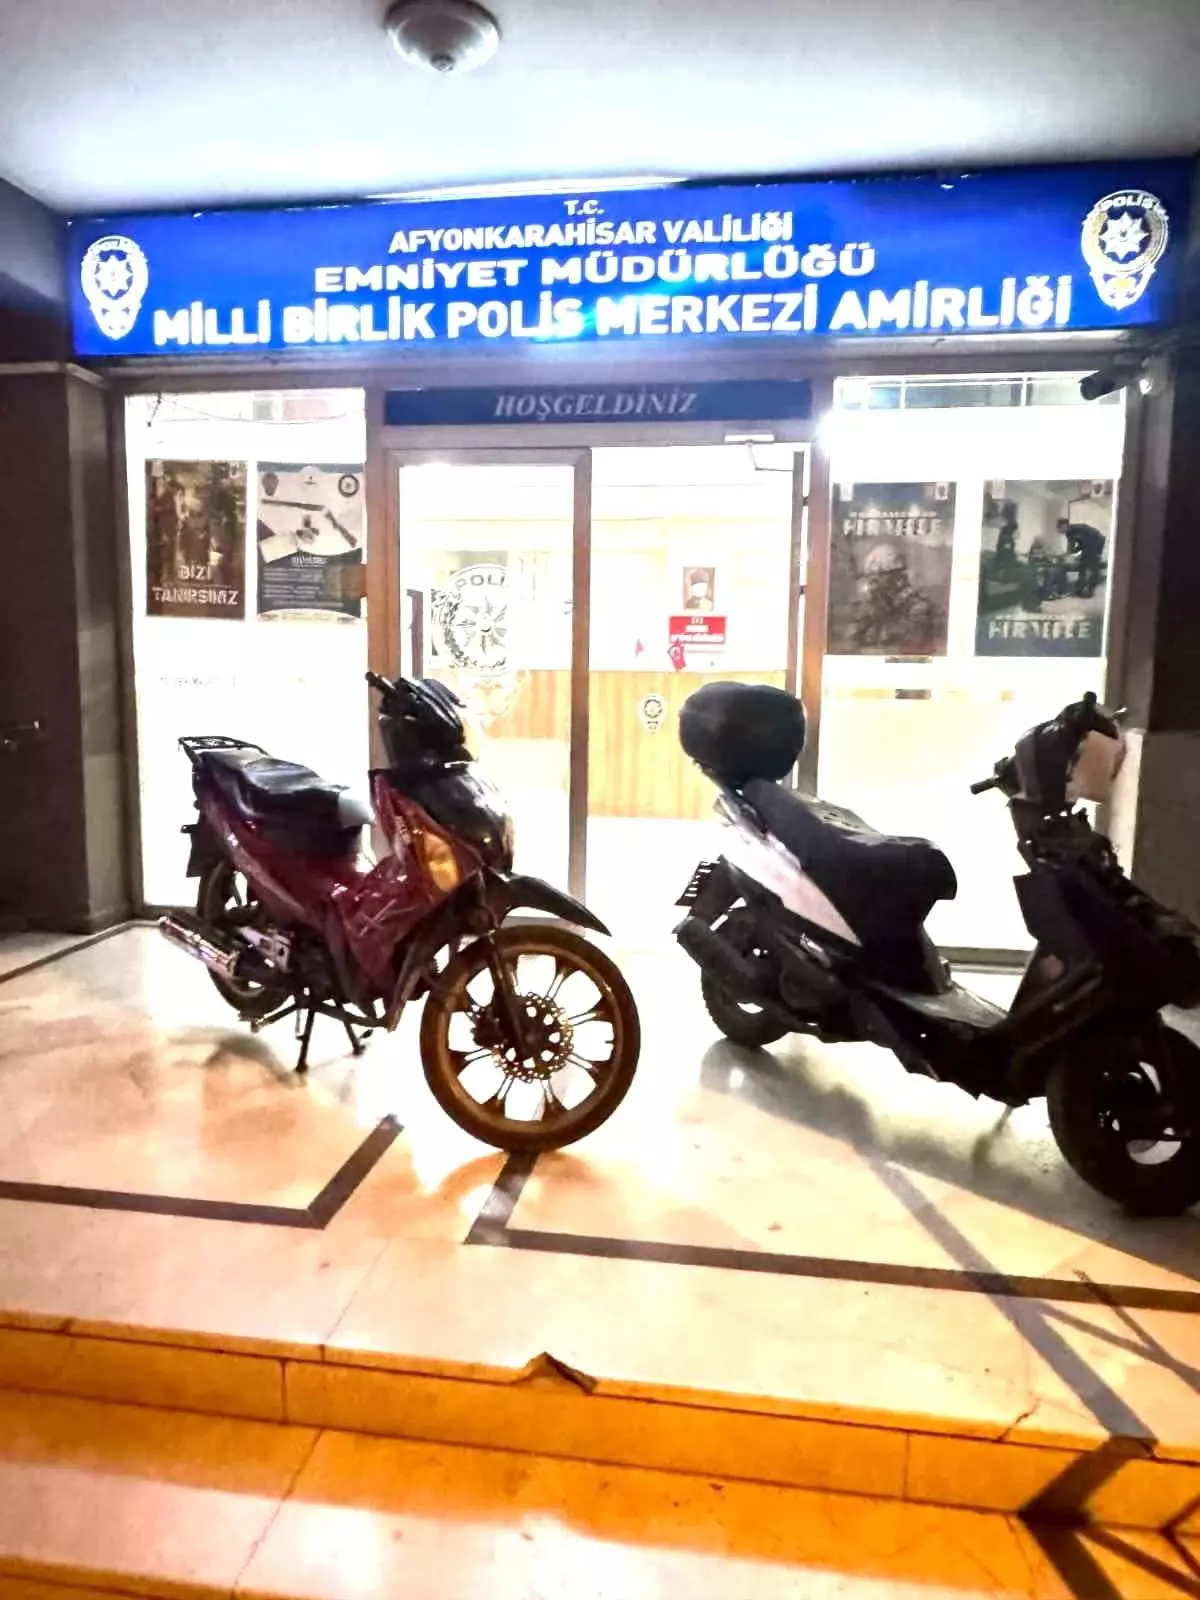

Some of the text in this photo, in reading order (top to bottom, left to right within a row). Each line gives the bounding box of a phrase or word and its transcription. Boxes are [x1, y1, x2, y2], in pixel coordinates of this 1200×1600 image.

[564, 200, 605, 215] T.C.
[388, 211, 793, 254] AFYONKARAHİSAR VALİLİĞİ
[314, 242, 876, 292] EMNİYET MÜDÜRLÜĞÜ
[154, 275, 1072, 346] MİLLİ BİRLİK POLİS MERKEZİ AMİRLİĞİ
[494, 387, 698, 420] HOŞGELDİNİZ
